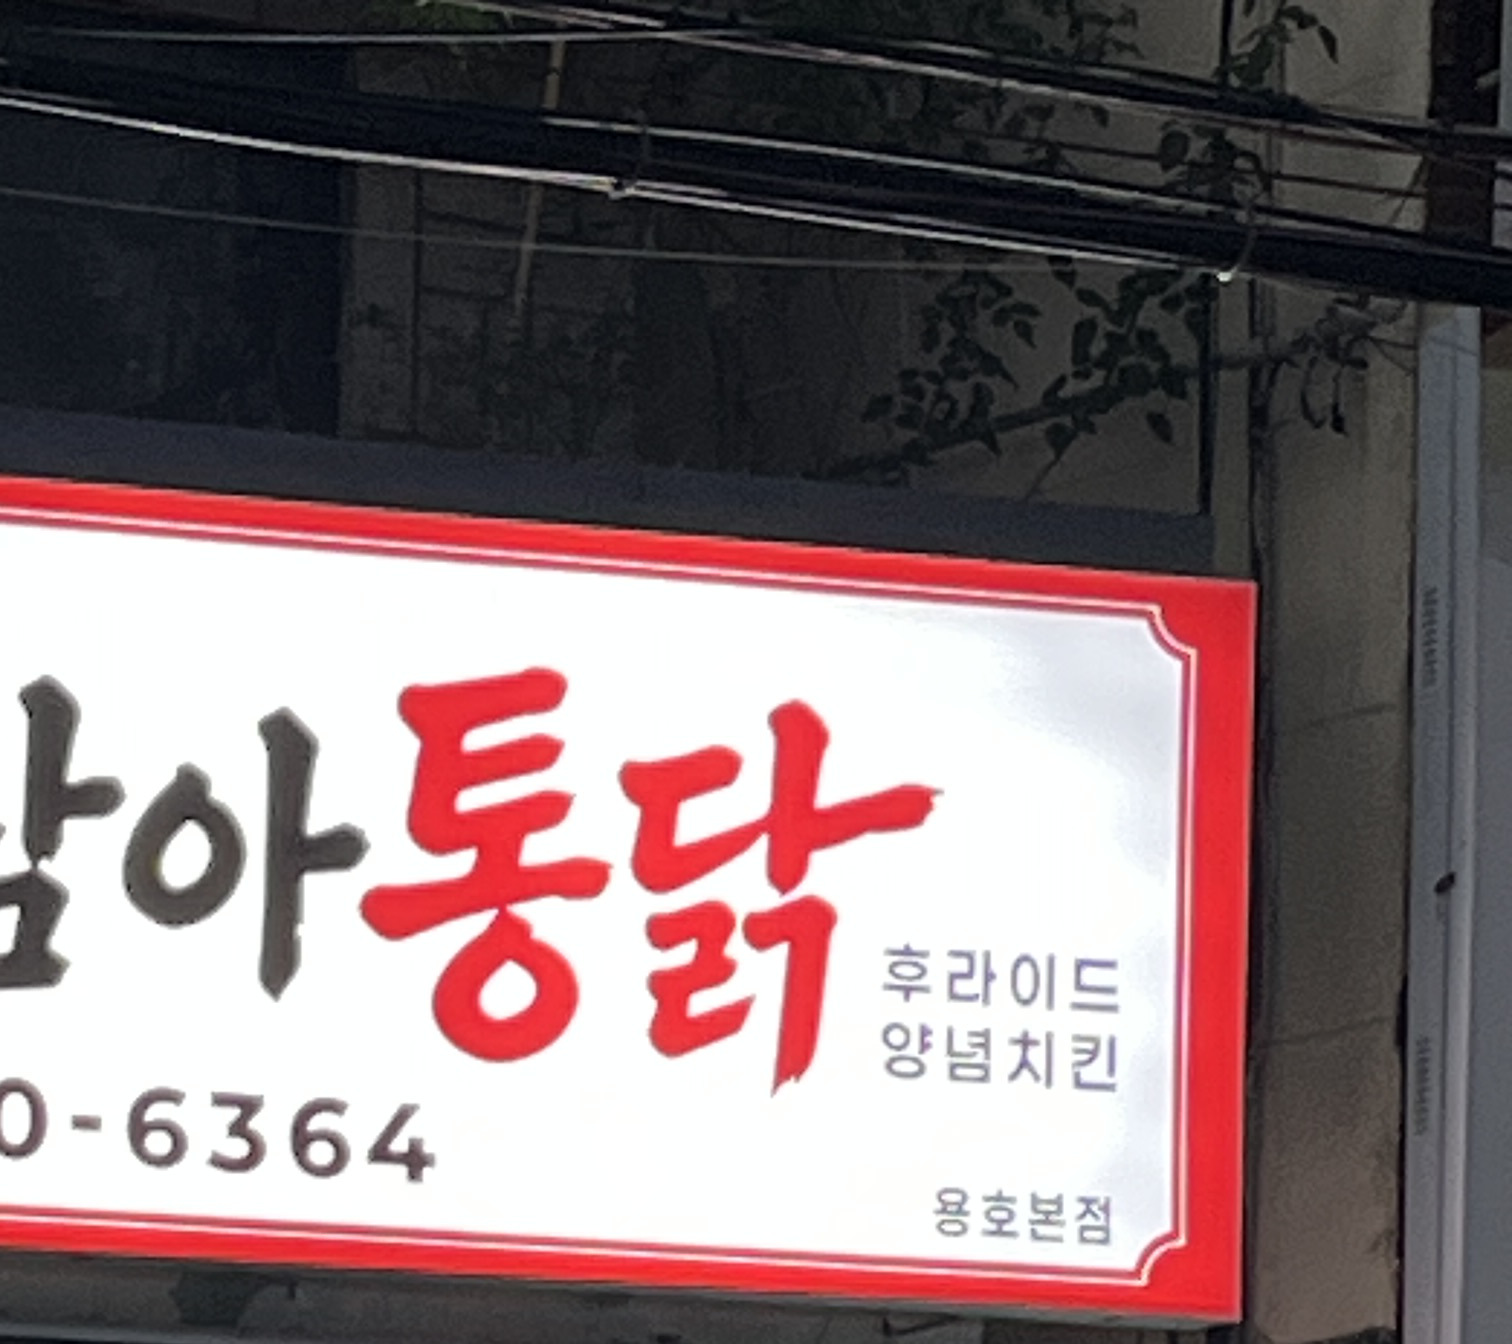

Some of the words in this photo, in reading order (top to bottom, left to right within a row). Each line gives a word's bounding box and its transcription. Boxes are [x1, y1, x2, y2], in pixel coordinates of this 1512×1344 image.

[882, 943, 1121, 1014] 후라이드
[881, 1019, 1121, 1091] 양념치킨
[932, 1188, 1113, 1246] 용호본점
